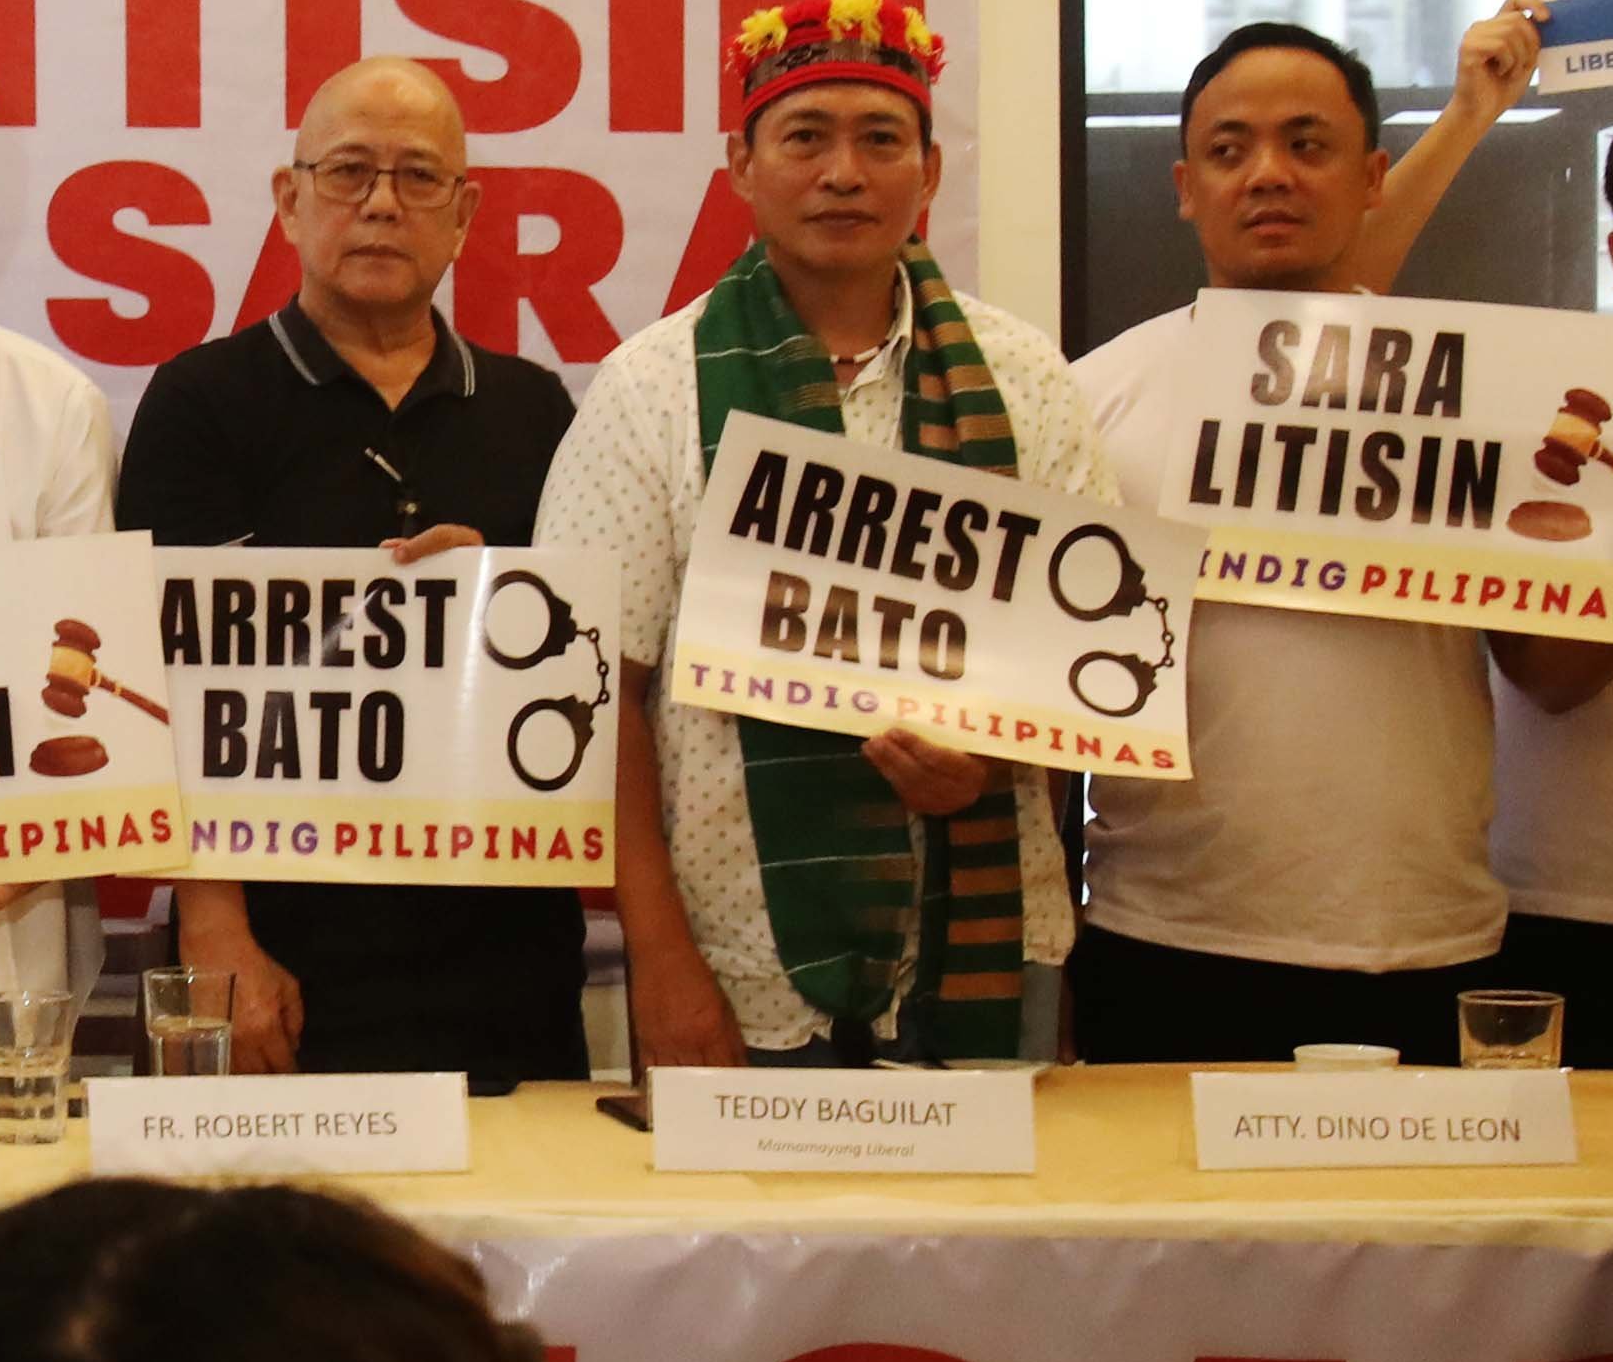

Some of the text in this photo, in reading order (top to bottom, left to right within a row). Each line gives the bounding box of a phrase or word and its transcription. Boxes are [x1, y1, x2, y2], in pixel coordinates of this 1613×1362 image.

[45, 159, 929, 367] SR
[1250, 320, 1467, 419] SARA
[1188, 420, 1502, 532] LITISIN
[729, 450, 1041, 602] ARREST
[1197, 550, 1347, 592] INDIG
[161, 577, 456, 669] ARREST
[759, 571, 968, 681] BATO
[202, 689, 405, 784] BATO
[690, 663, 1176, 771] TINDIG PILIPINAS
[193, 820, 605, 861] NDIG PILIPINAS
[143, 1111, 398, 1139] FR. ROBERT REYES
[714, 1095, 958, 1127] TEDDY BAGUILAT
[866, 1141, 914, 1157] Liberal
[1234, 1114, 1522, 1142] ATTY. DINO DE LEON
